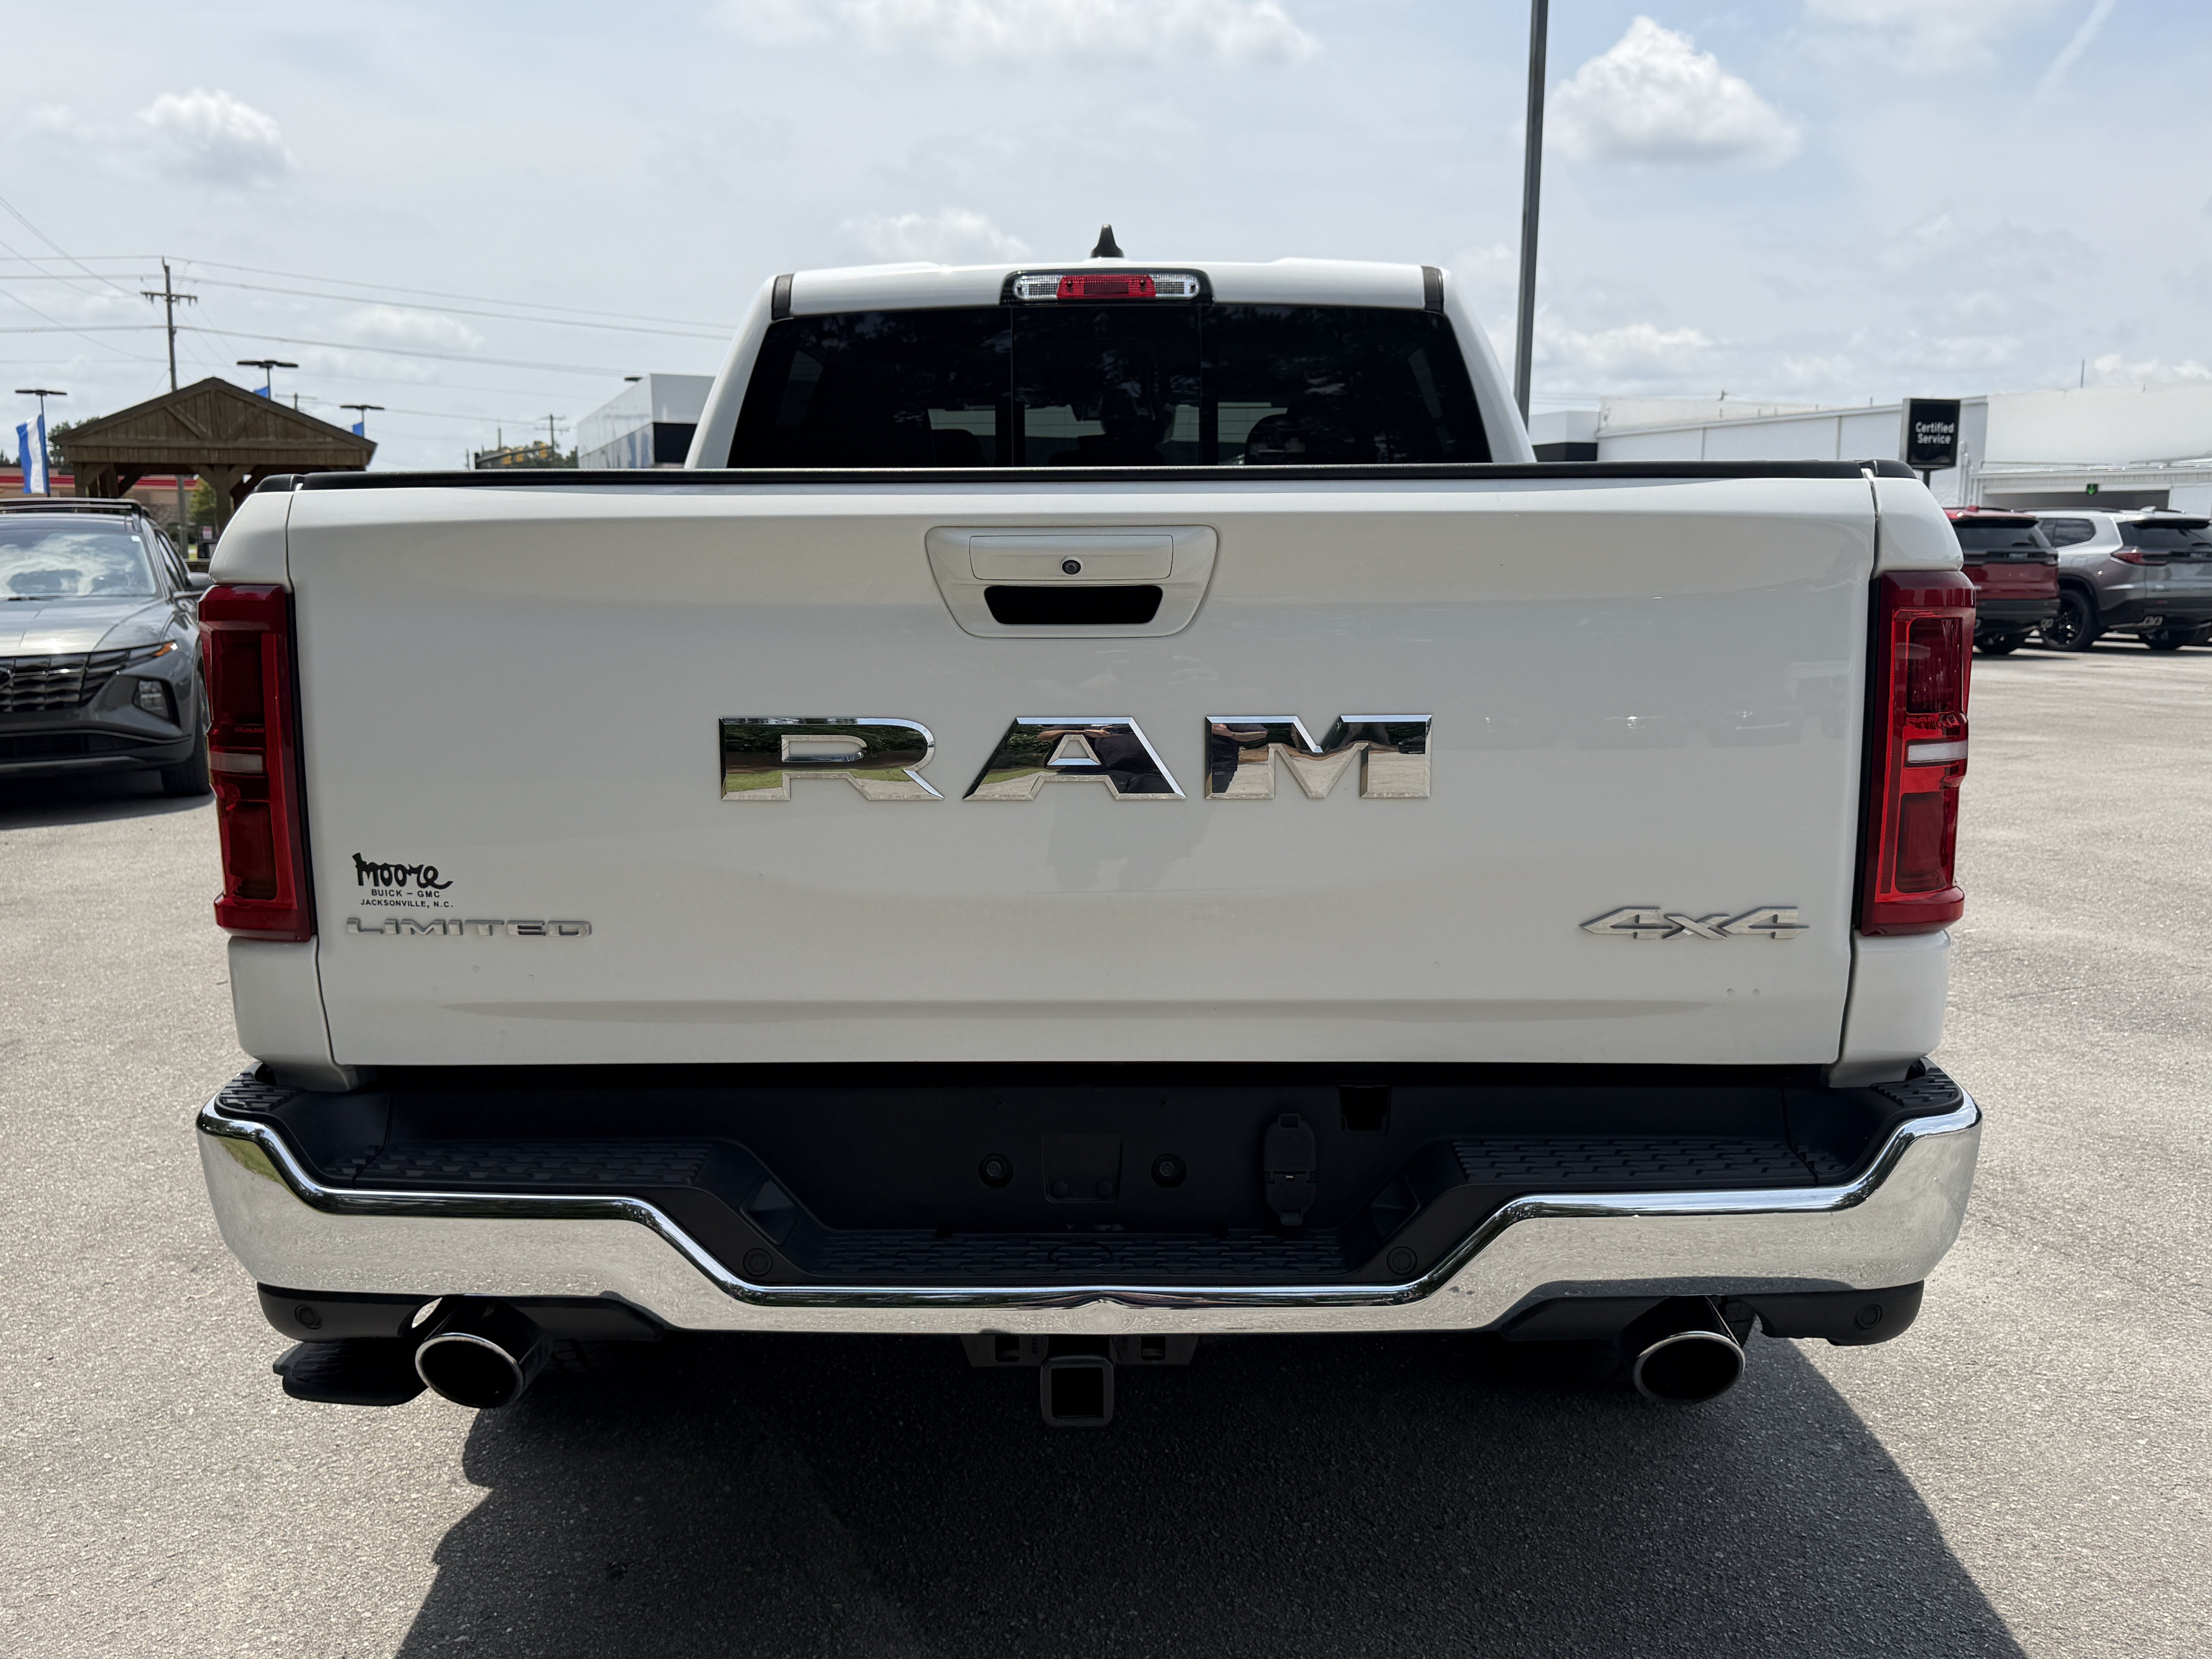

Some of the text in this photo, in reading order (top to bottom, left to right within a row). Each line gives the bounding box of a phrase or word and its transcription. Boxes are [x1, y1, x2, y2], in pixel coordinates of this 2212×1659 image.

[1915, 421, 1954, 433] Certified
[1917, 433, 1951, 444] Service
[718, 714, 1433, 800] RAM
[371, 889, 402, 897] BUICK
[361, 899, 429, 908] JACKSONVILLE,
[347, 917, 592, 936] LIMITED
